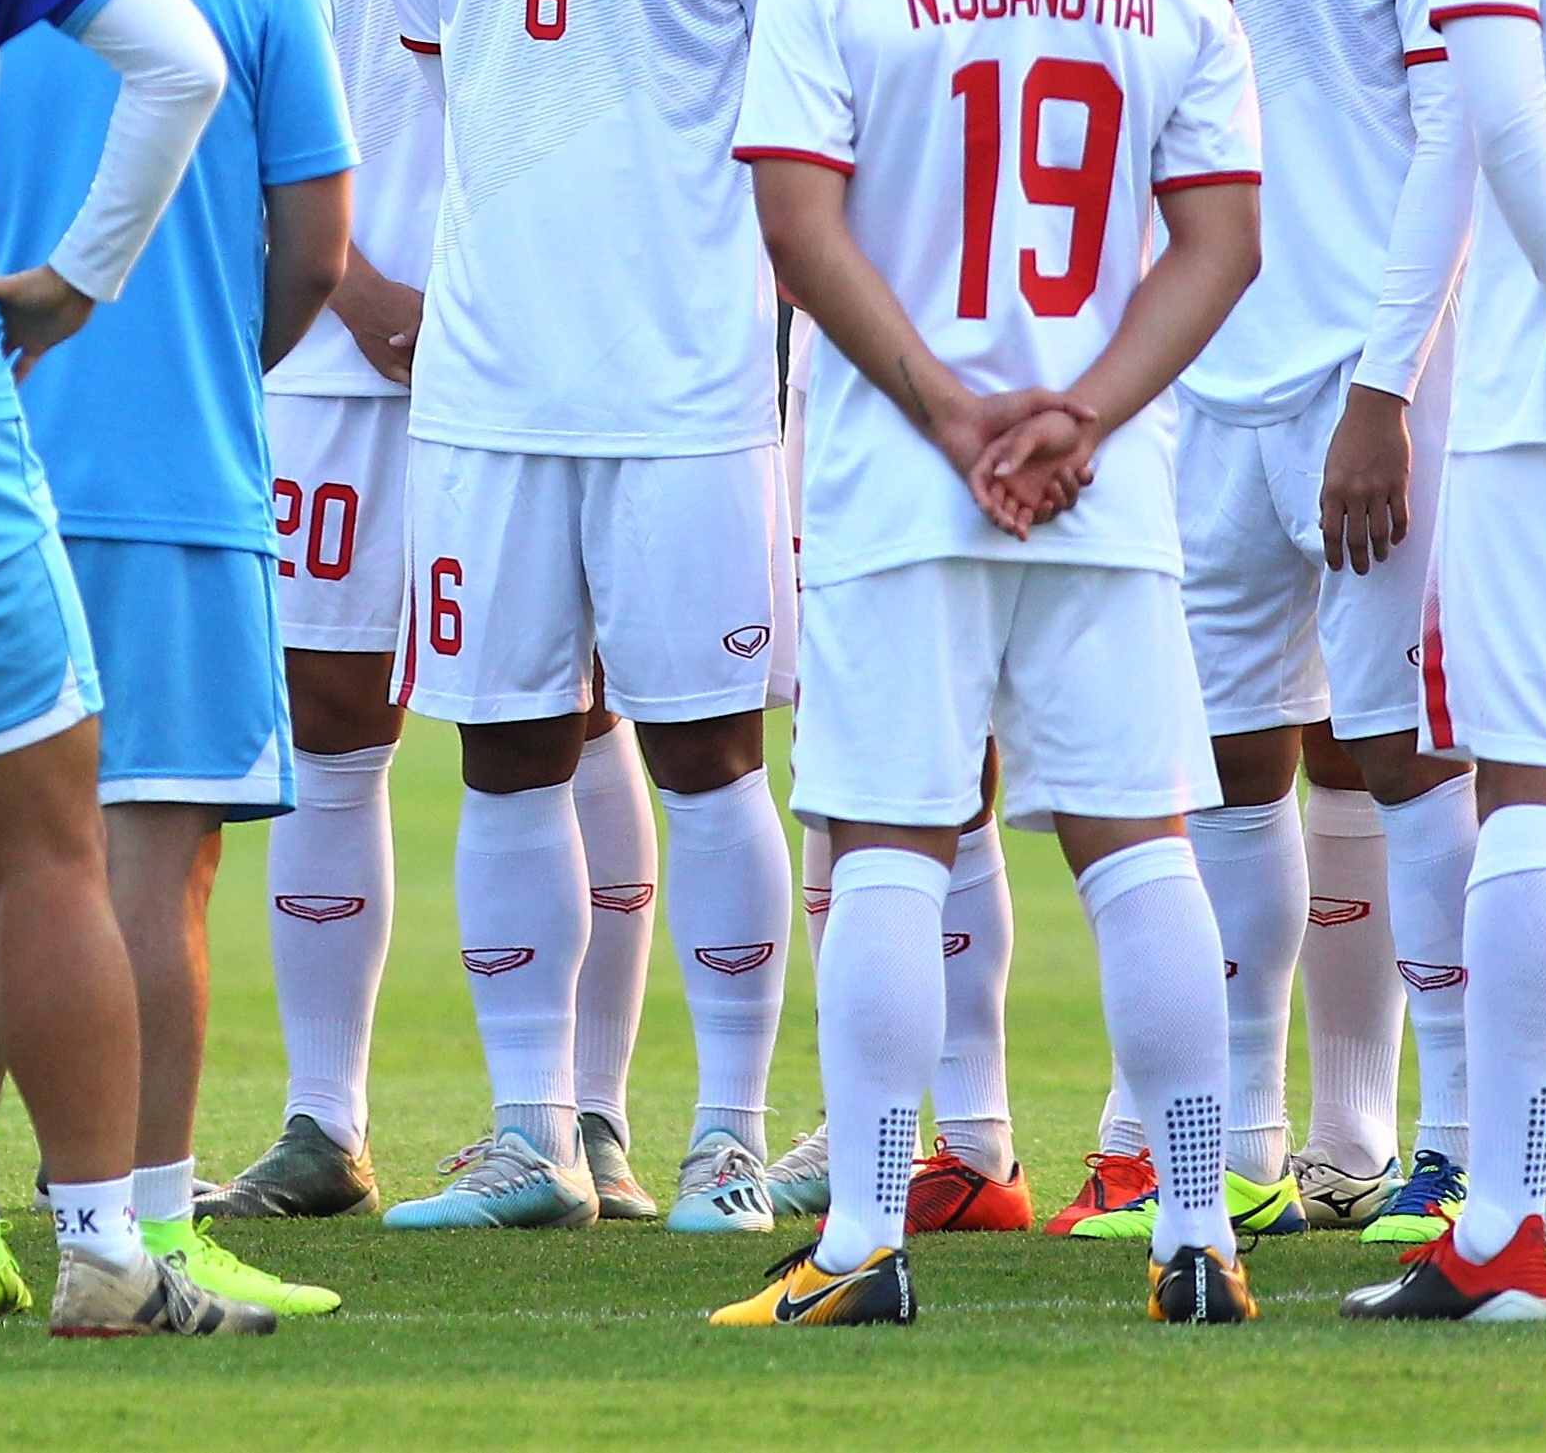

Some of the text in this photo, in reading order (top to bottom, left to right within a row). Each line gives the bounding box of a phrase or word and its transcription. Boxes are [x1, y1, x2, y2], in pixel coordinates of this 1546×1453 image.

[950, 56, 1125, 320] 19
[272, 477, 360, 582] 20
[429, 556, 464, 657] 6
